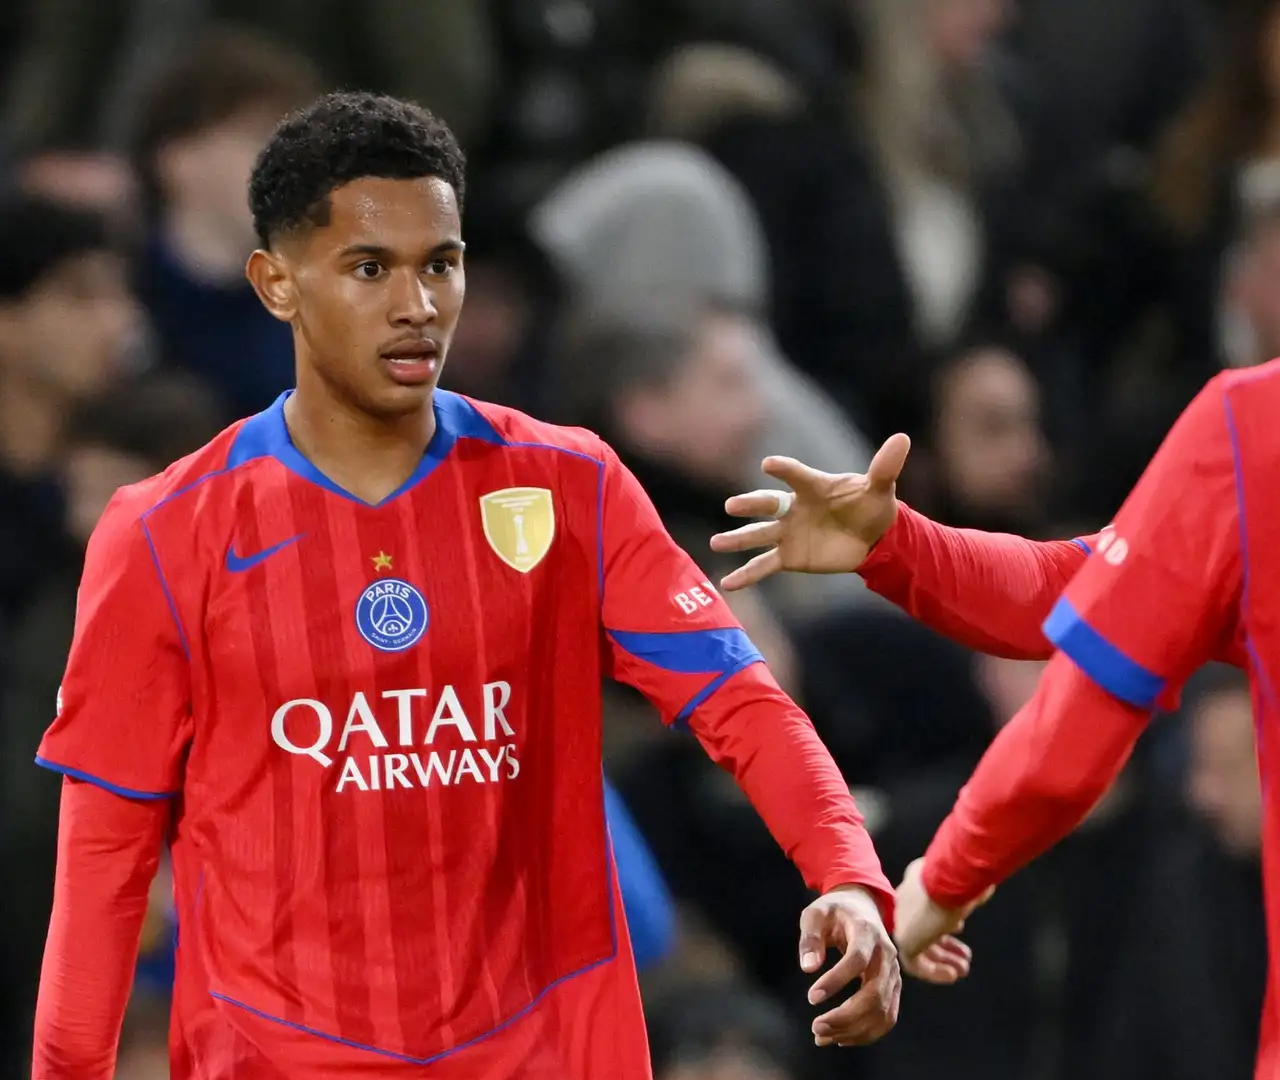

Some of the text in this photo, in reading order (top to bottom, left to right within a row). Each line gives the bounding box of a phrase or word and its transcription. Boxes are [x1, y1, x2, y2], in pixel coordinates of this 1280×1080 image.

[365, 583, 411, 602] PARIS
[270, 680, 516, 768] QATAR
[335, 743, 520, 793] AIRWAYS
